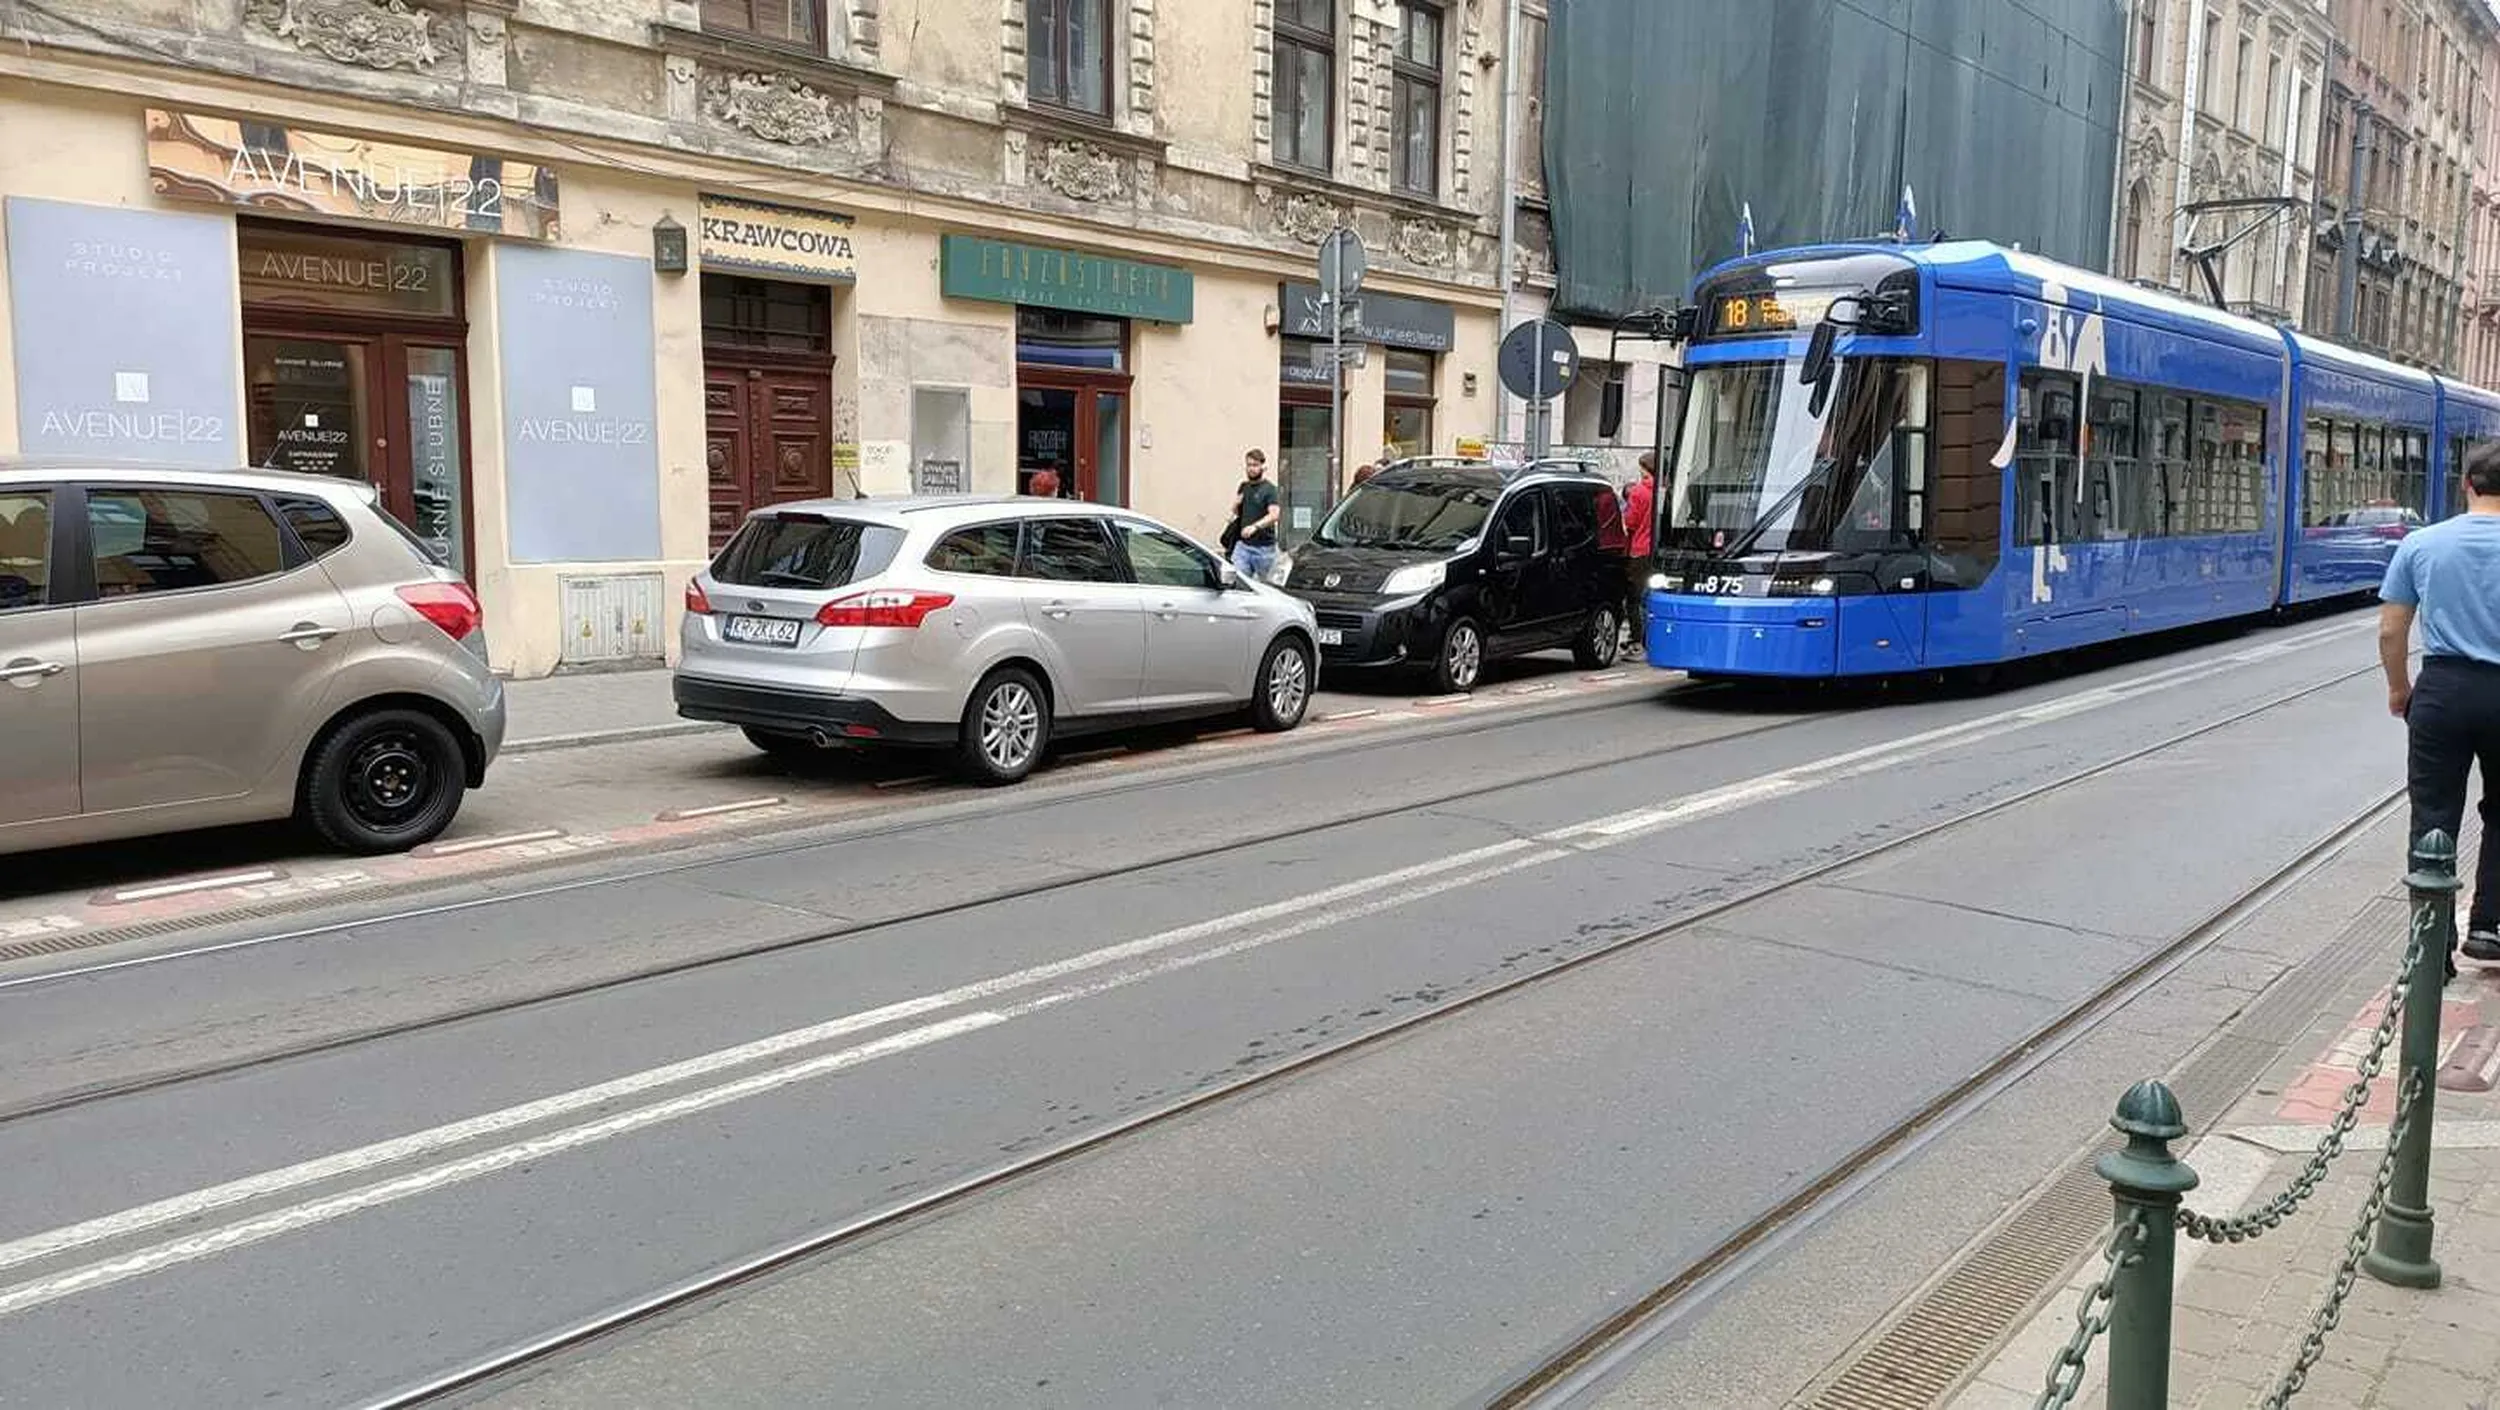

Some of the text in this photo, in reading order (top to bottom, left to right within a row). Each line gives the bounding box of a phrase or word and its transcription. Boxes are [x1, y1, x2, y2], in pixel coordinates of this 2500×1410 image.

[71, 241, 174, 263] STUDIO
[702, 217, 854, 259] KRAWCOWA
[1725, 299, 1748, 328] 18
